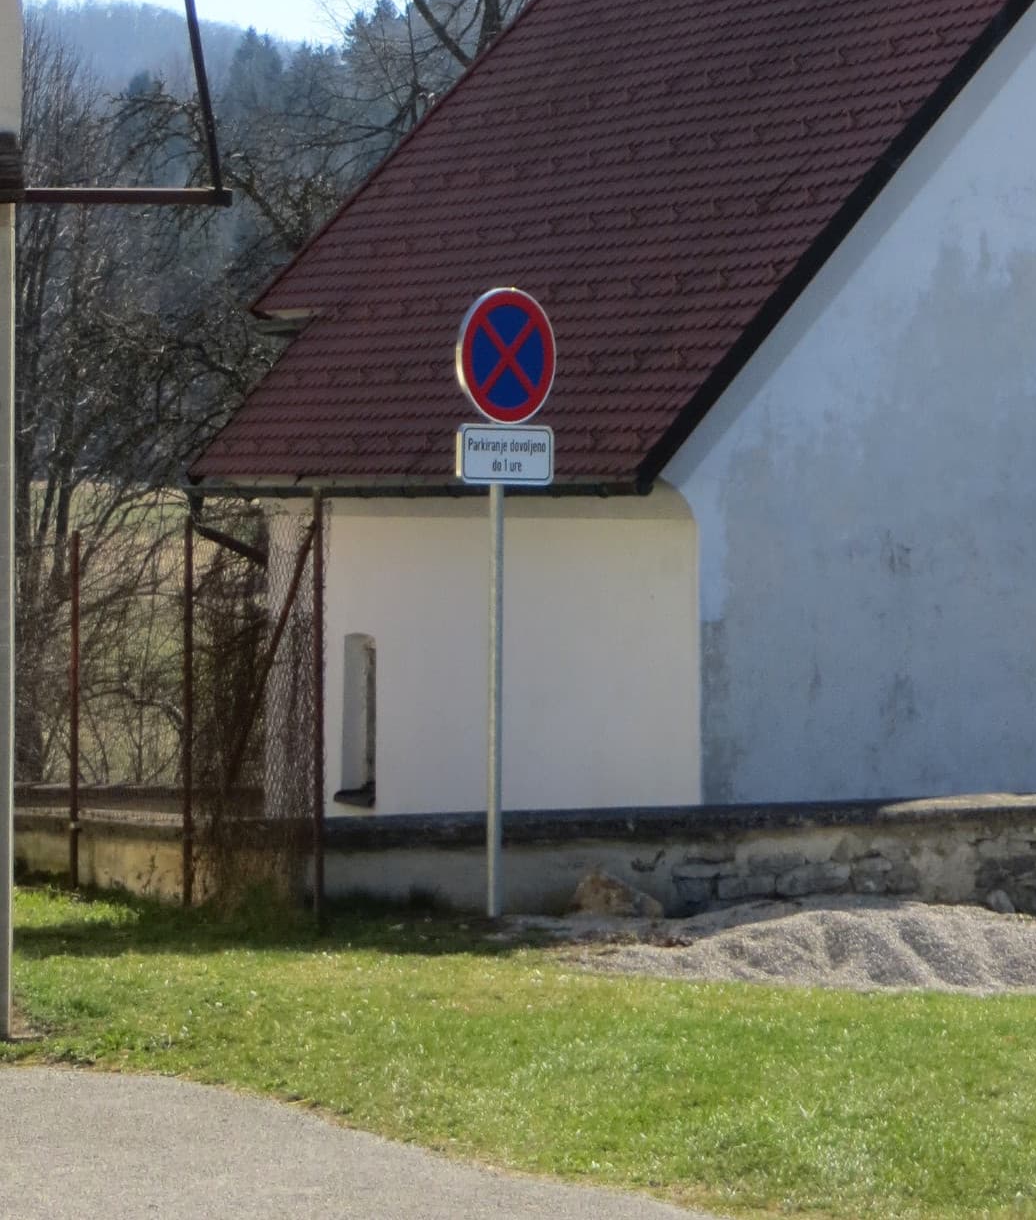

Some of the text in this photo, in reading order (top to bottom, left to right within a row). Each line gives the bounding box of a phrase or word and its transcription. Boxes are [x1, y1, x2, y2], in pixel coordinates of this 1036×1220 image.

[468, 437, 547, 456] Parkiranje dovoljeno
[492, 459, 502, 472] do
[510, 461, 523, 472] ure
